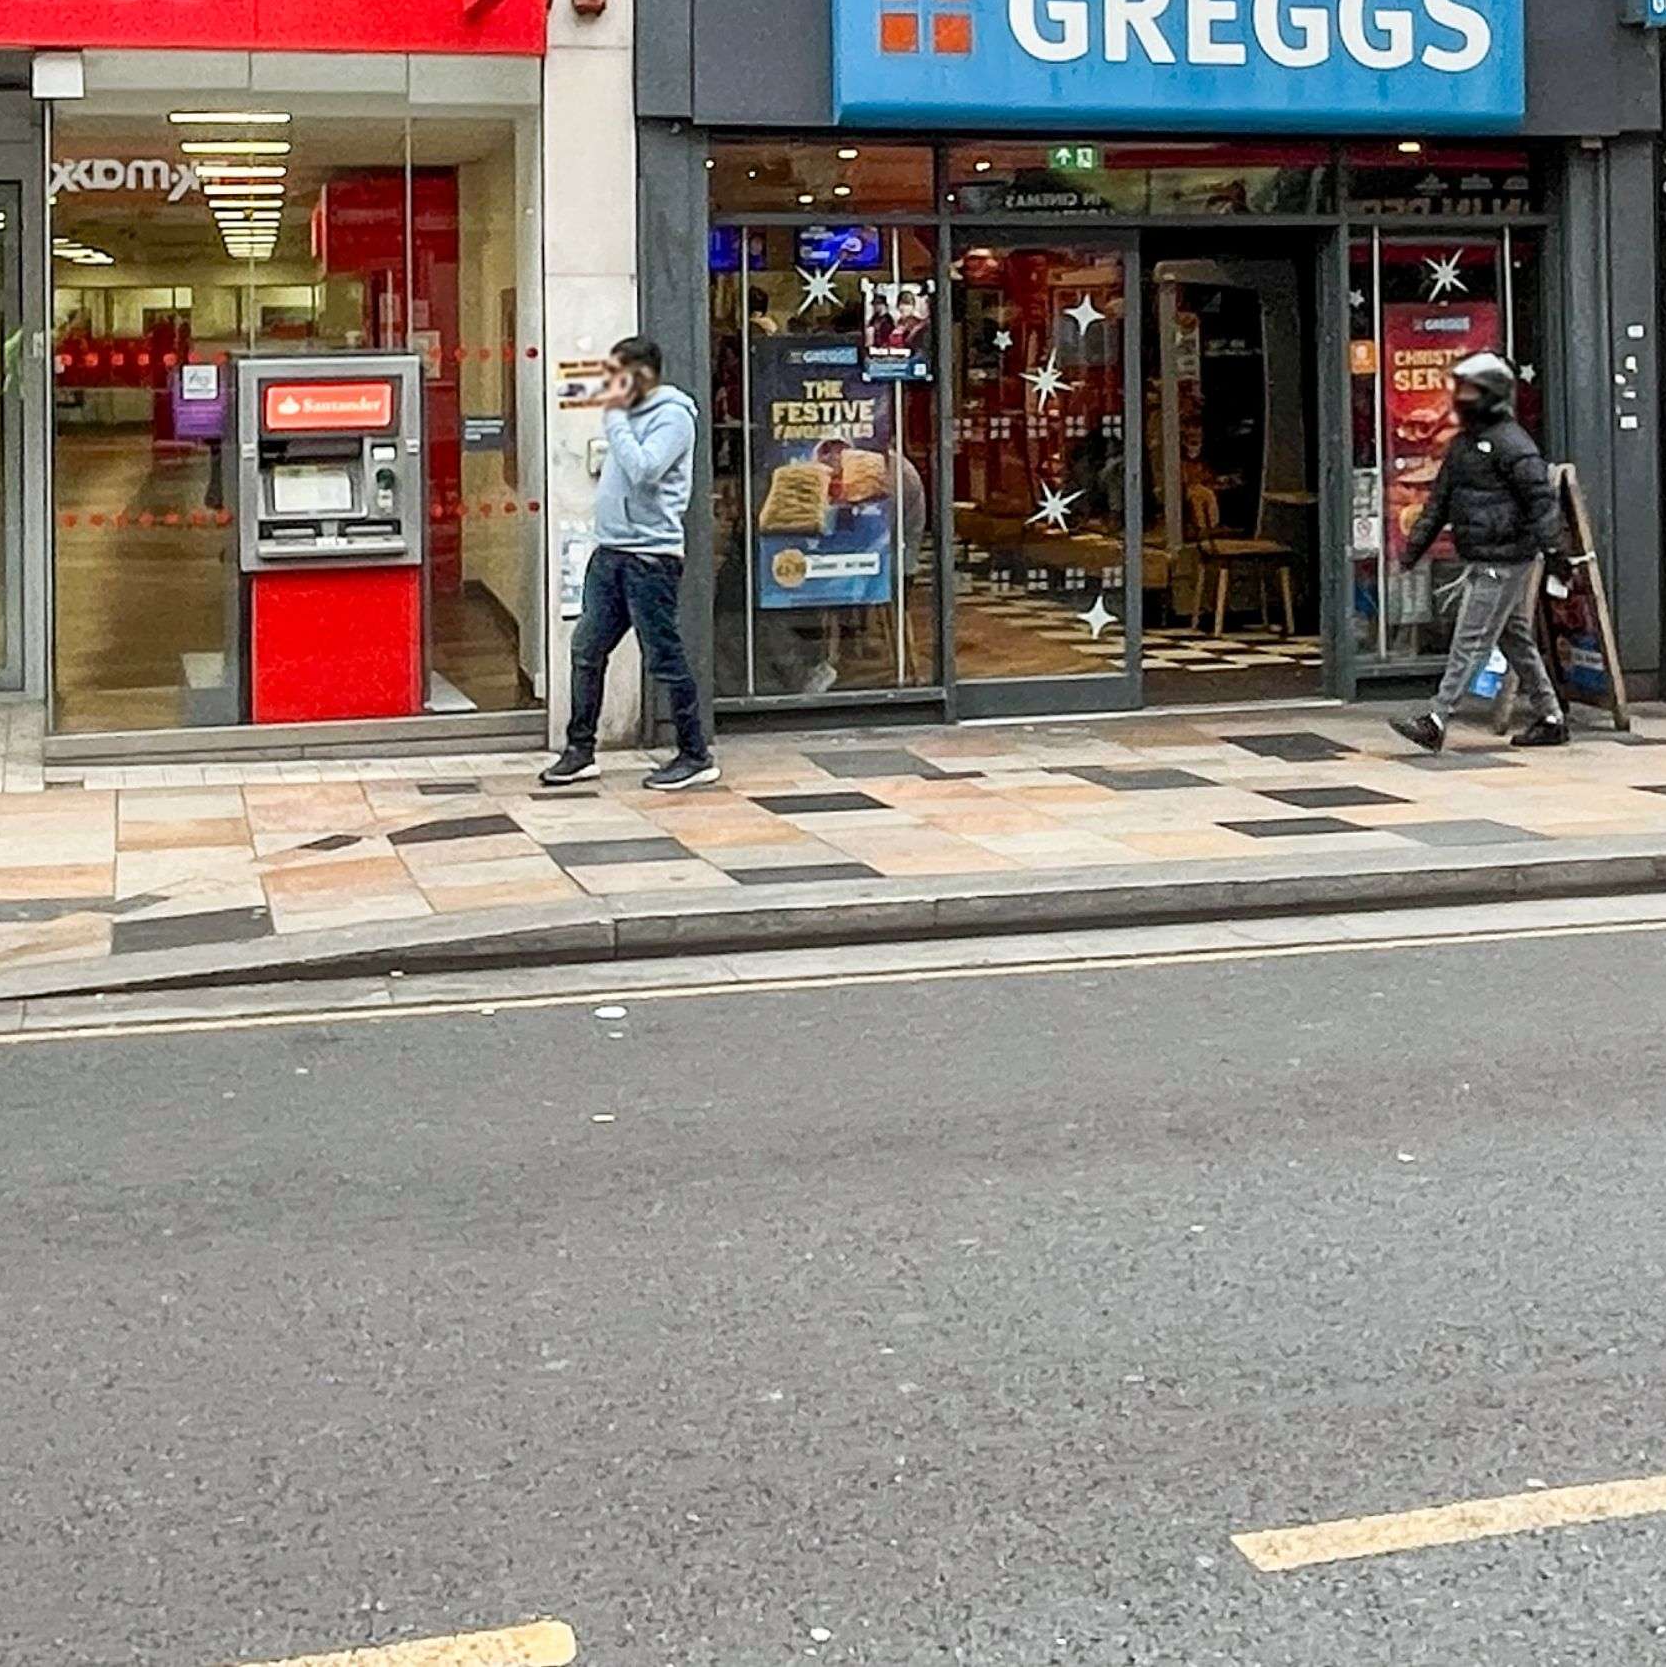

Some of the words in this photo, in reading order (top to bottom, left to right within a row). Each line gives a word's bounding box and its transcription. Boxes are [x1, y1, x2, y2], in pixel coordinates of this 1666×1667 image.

[803, 380, 844, 399] THE
[302, 396, 381, 413] Santander
[772, 399, 875, 423] FESTIVE
